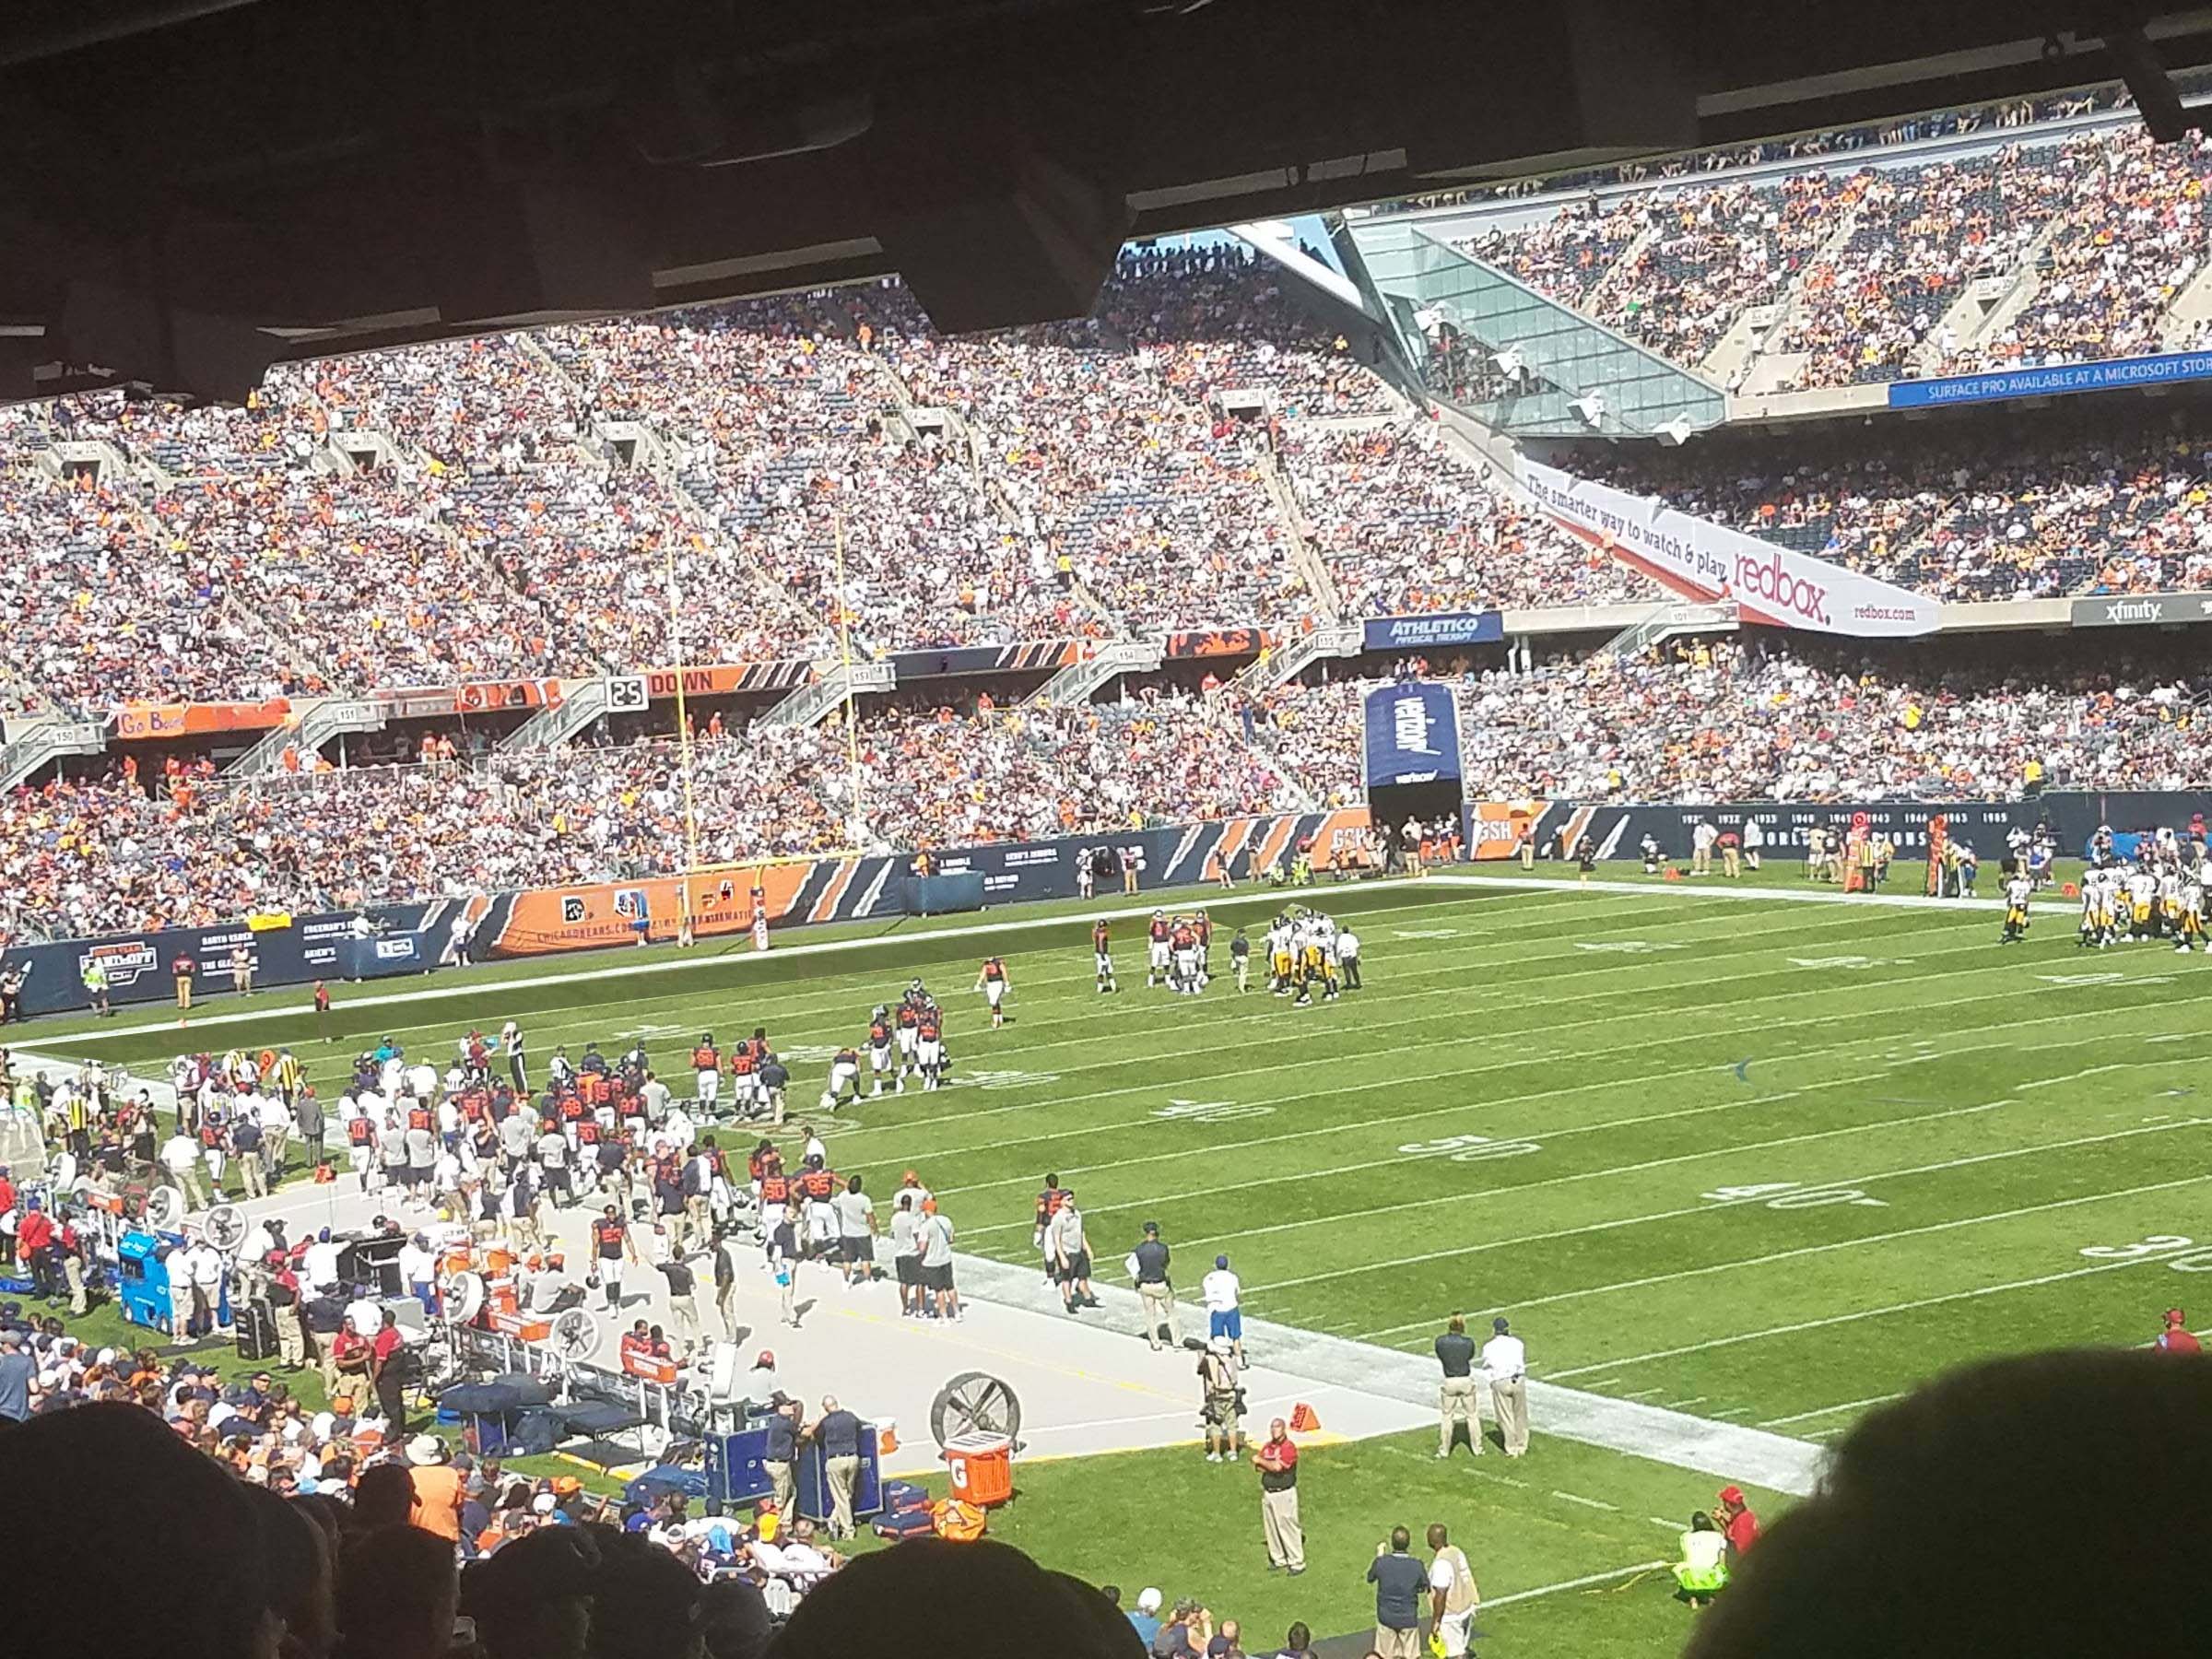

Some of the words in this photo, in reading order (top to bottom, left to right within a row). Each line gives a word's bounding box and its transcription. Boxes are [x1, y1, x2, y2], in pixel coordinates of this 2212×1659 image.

[1928, 382, 1981, 399] SURFACE
[1982, 378, 2006, 394] PRO
[2008, 371, 2073, 392] AVAILABLE
[2075, 369, 2089, 385] AT
[2092, 369, 2103, 383] A
[2105, 361, 2178, 382] MICROSOFT
[1526, 474, 1549, 500] The
[1551, 489, 1597, 521] smarter
[1600, 511, 1625, 537] way
[1628, 519, 1641, 540] to
[1643, 529, 1683, 558] watch
[1686, 544, 1694, 564] &
[1854, 604, 1916, 622] redbox.com
[1390, 618, 1478, 637] ATHLETICO
[612, 682, 641, 706] 25
[651, 670, 713, 694] DOWN
[1397, 1134, 1545, 1162] 50
[1700, 1182, 1865, 1210] 40
[950, 1458, 968, 1489] G
